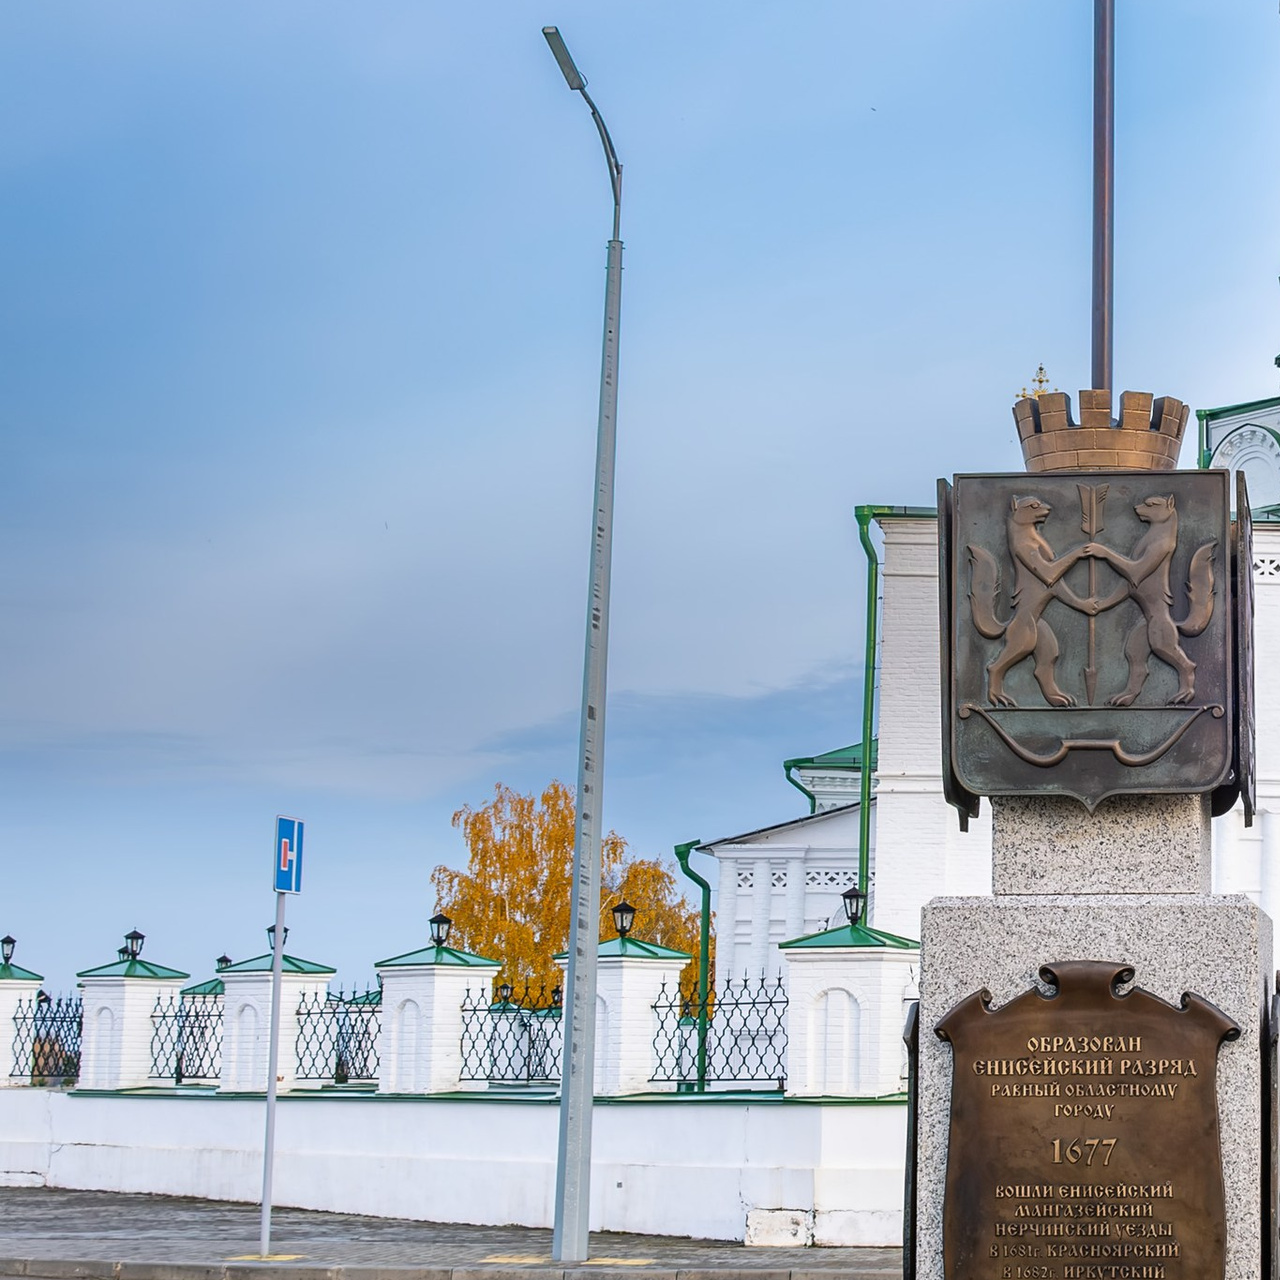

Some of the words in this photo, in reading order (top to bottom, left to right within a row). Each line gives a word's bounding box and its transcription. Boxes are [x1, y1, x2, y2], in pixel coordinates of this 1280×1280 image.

[1027, 1036, 1142, 1054] ОБРАЗОВАН
[973, 1057, 1113, 1076] ЕНИСЕЙСКИЙ
[1120, 1059, 1198, 1077] РАЗРЯД
[991, 1081, 1060, 1097] РАВНЫЙ
[1065, 1083, 1178, 1099] ОБЛАСТНОМУ
[1054, 1104, 1115, 1119] ГОРОДУ
[1051, 1138, 1118, 1166] 1677
[995, 1185, 1053, 1198] ВОШЛИ
[1058, 1181, 1174, 1199] ЕНИСЕЙСКИЙ
[1014, 1202, 1154, 1219] МАНГАЗЕЙСКИЙ
[995, 1221, 1111, 1237] НЕРЧИНСКИЙ
[1115, 1223, 1173, 1240] УЕЗДЫ
[989, 1245, 998, 1257] В
[1046, 1242, 1180, 1258] КРАСНОЯРСКИЙ
[1002, 1267, 1011, 1279] В
